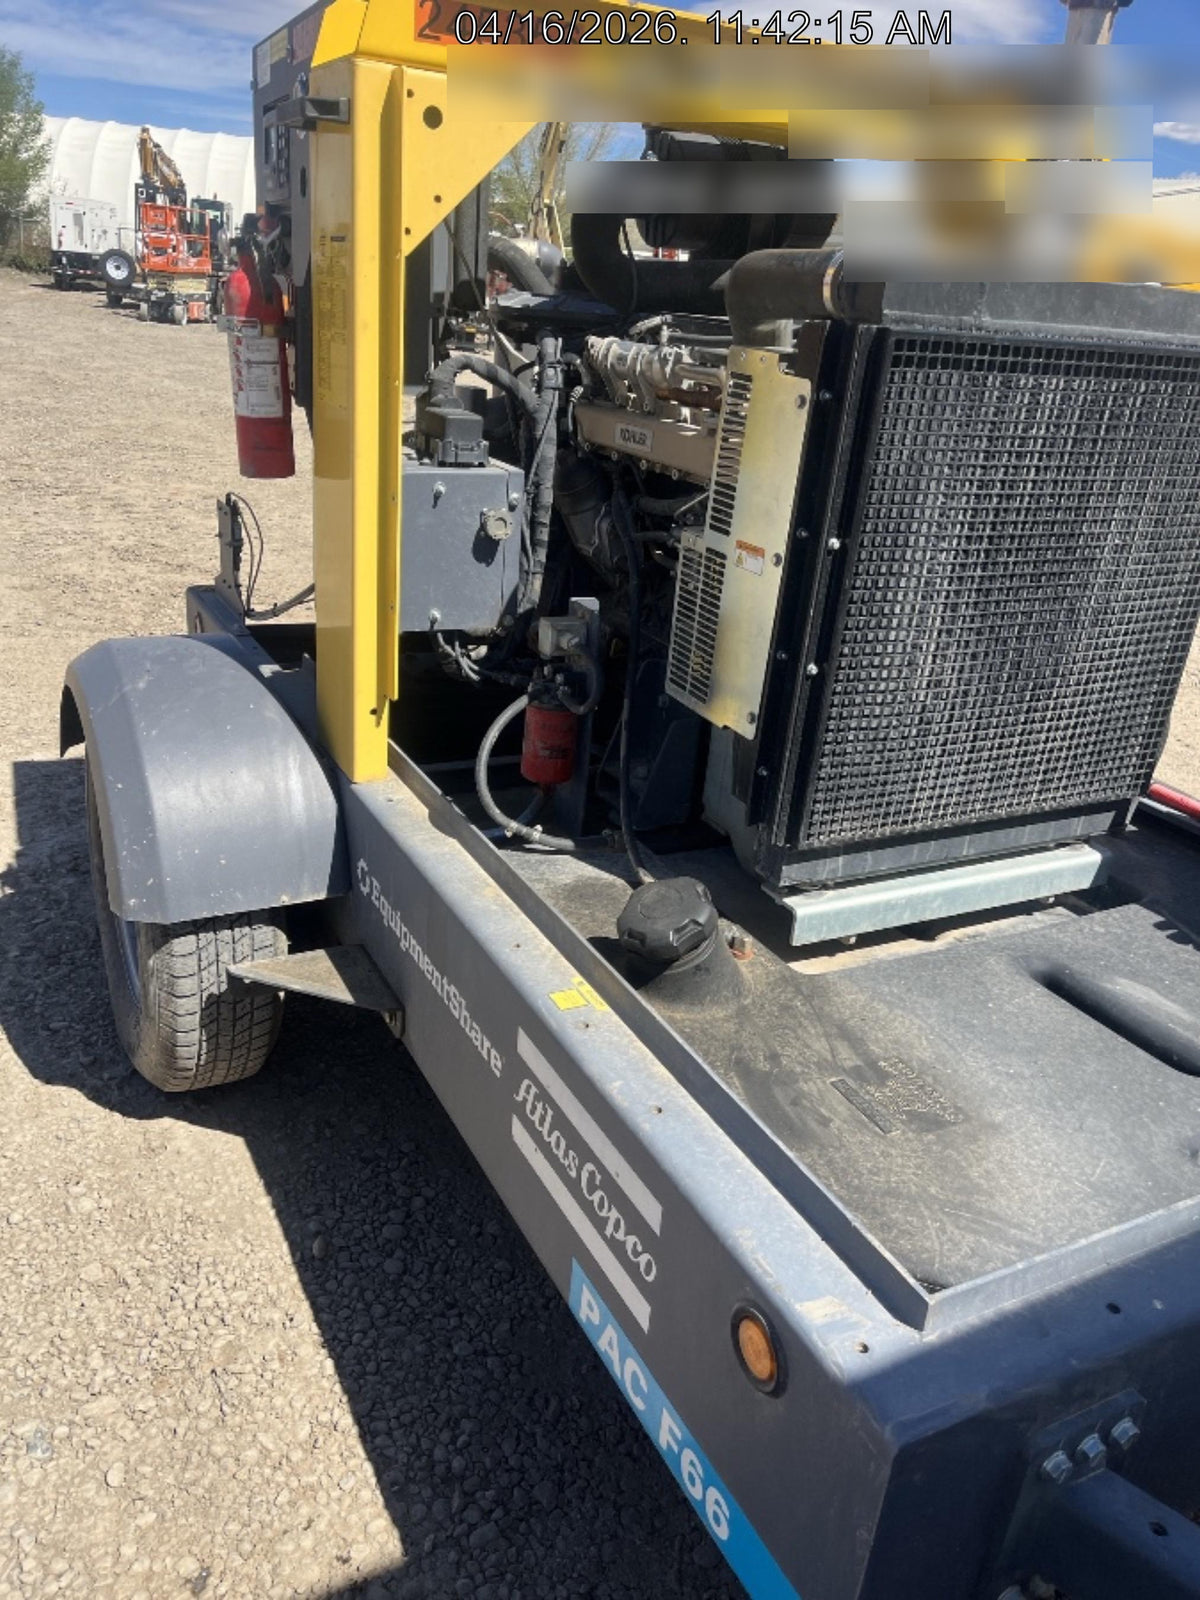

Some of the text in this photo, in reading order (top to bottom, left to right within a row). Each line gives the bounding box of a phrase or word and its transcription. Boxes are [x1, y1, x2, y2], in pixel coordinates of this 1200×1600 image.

[370, 876, 503, 1078] EquipmentShare
[514, 1078, 657, 1283] Atlas Copco
[579, 1283, 730, 1541] PAC F66
